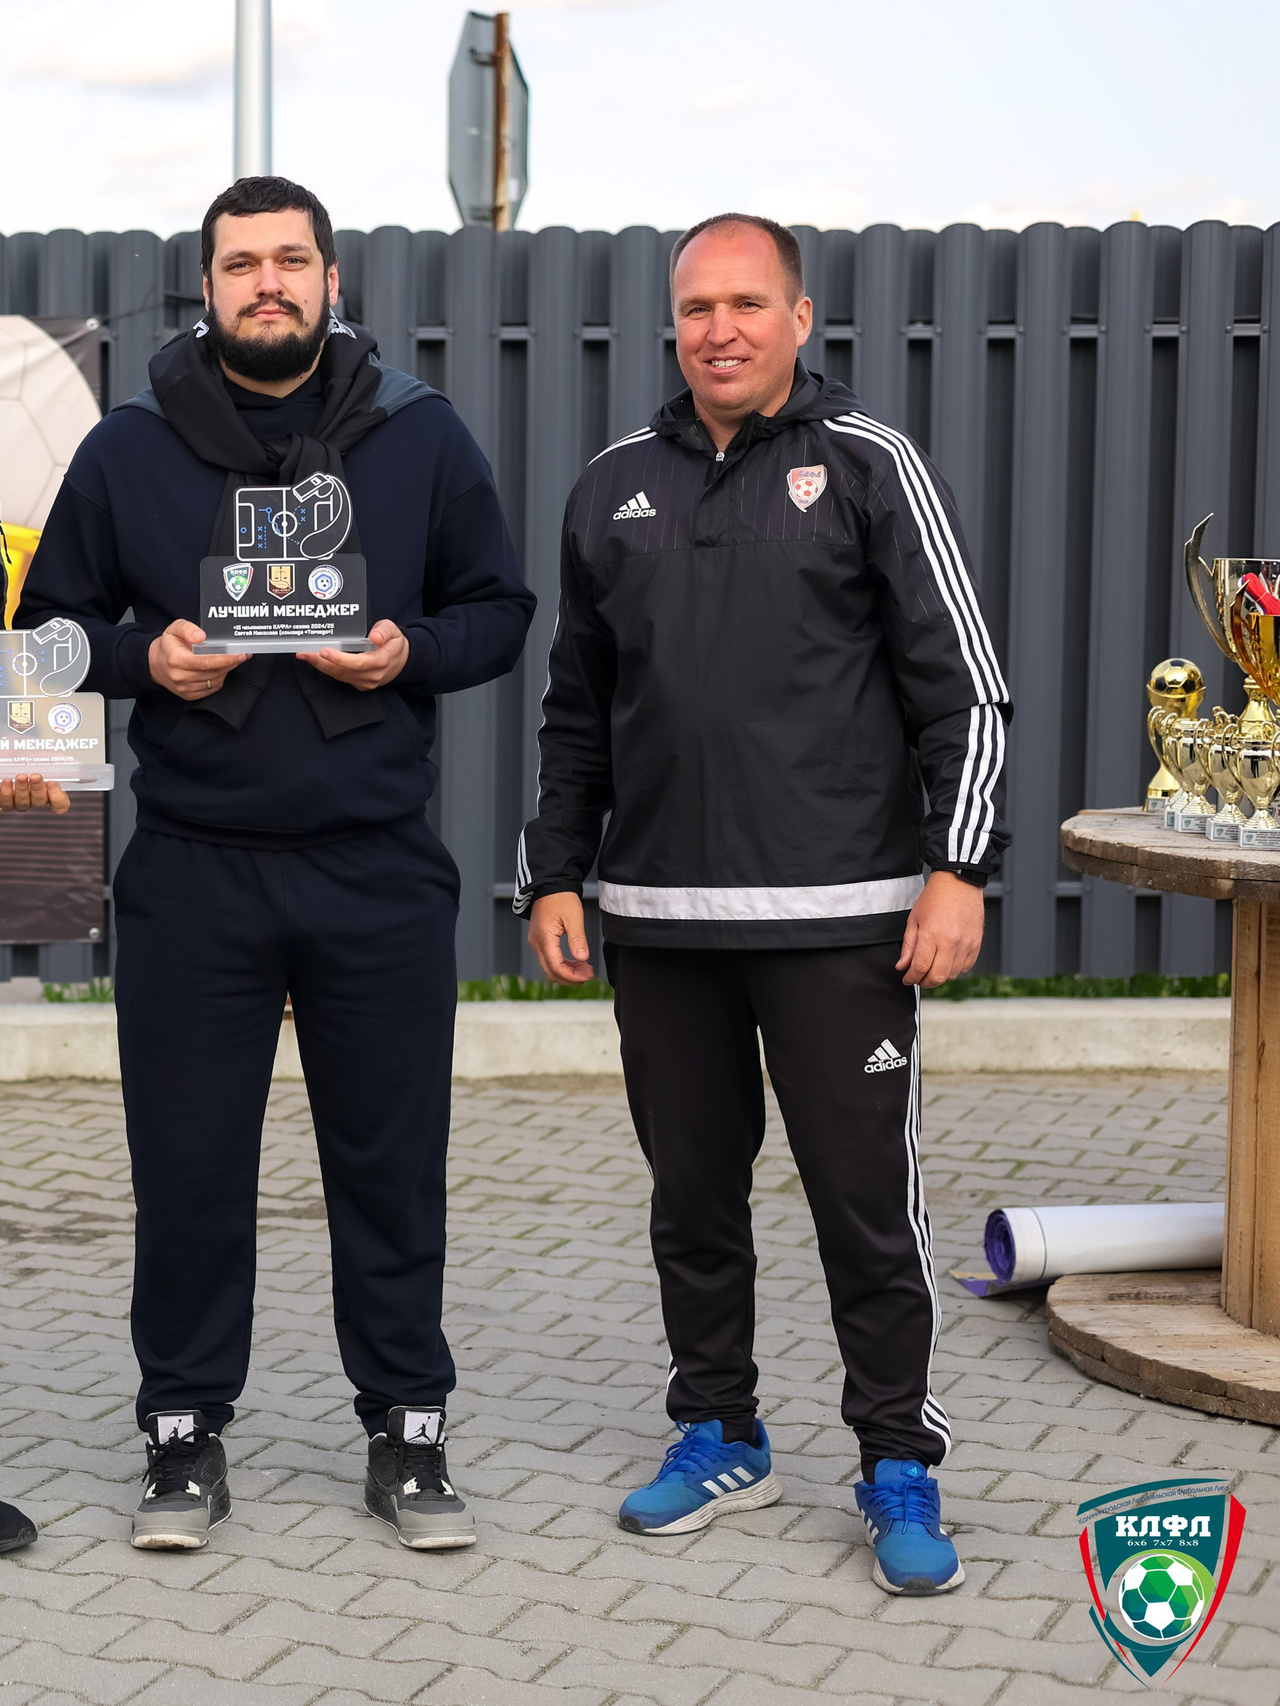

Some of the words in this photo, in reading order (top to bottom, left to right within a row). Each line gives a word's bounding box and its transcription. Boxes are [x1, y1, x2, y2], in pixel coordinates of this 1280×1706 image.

[612, 507, 657, 521] adidas
[208, 602, 269, 618] ЛУЧШИЙ
[273, 603, 360, 618] МЕНЕДЖЕР
[13, 738, 99, 752] МЕНЕДЖЕР
[863, 1056, 908, 1074] adidas
